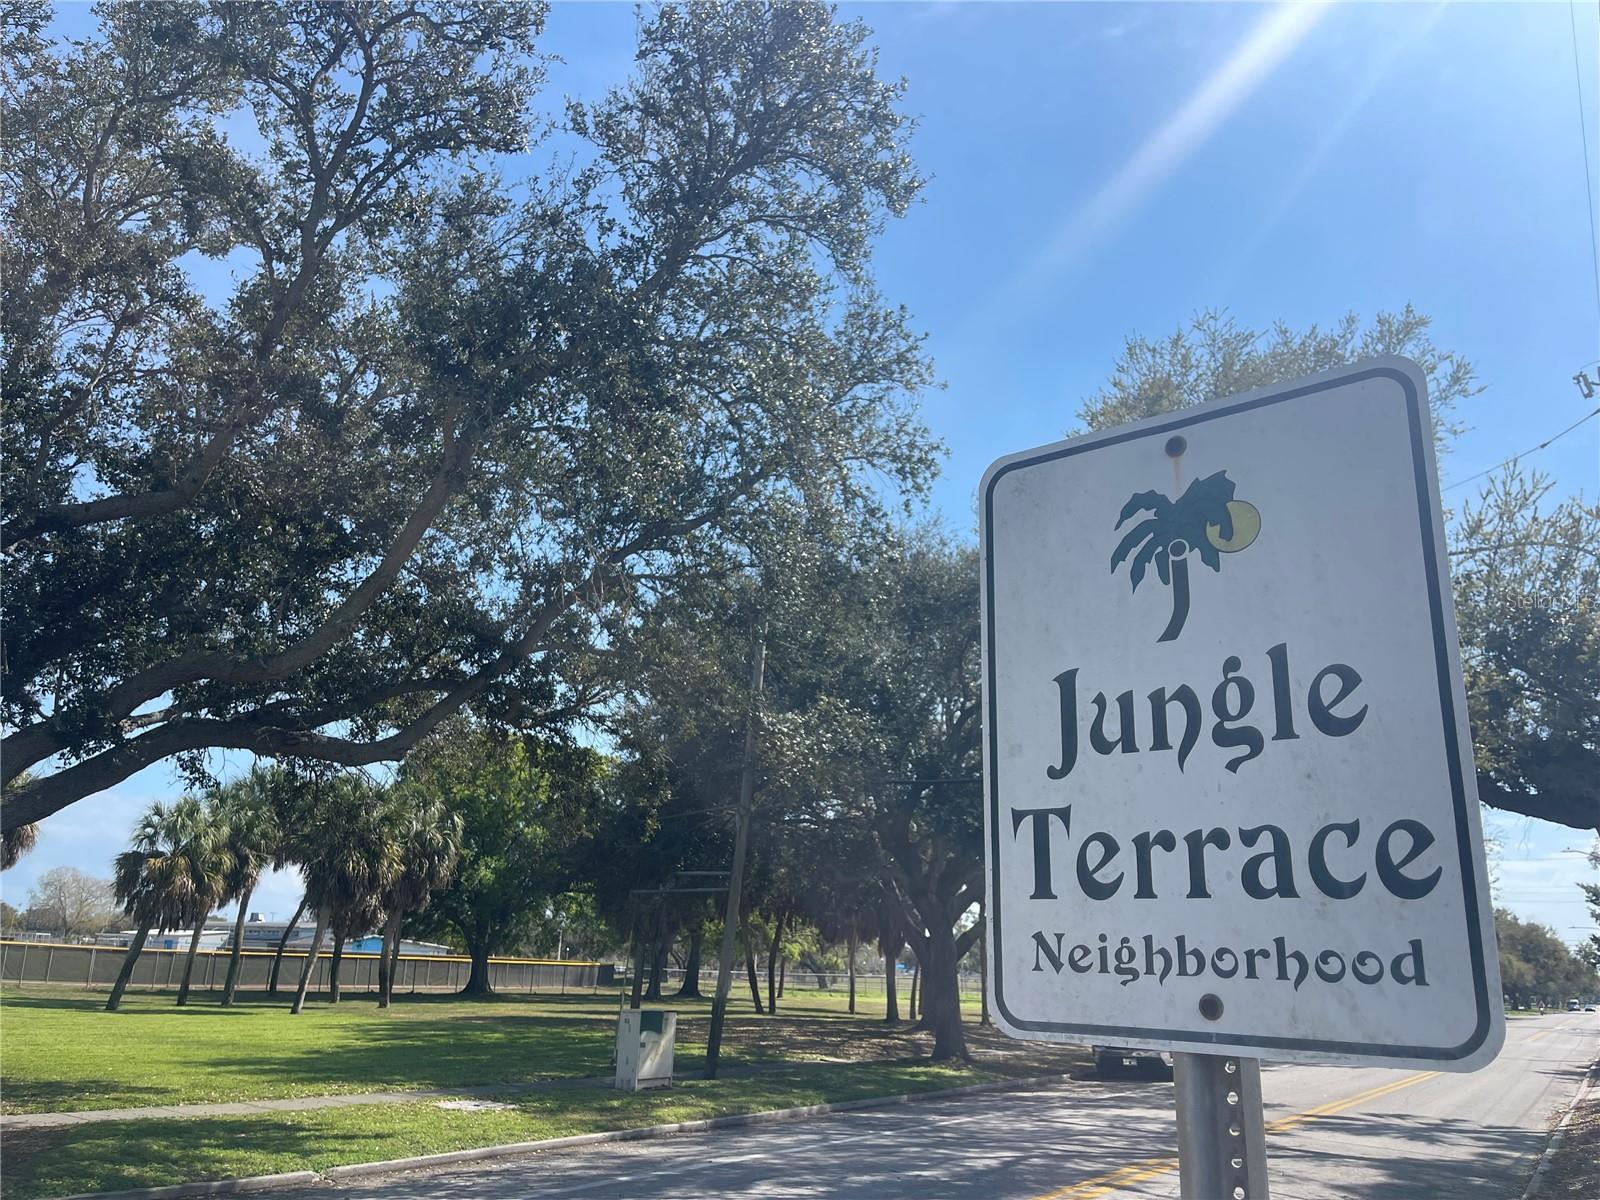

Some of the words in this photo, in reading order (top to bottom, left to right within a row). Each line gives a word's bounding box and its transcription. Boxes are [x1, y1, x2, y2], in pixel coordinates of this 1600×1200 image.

[1046, 643, 1369, 780] Jungle
[1011, 804, 1443, 900] Terrace
[1032, 931, 1430, 992] Neighborhood
